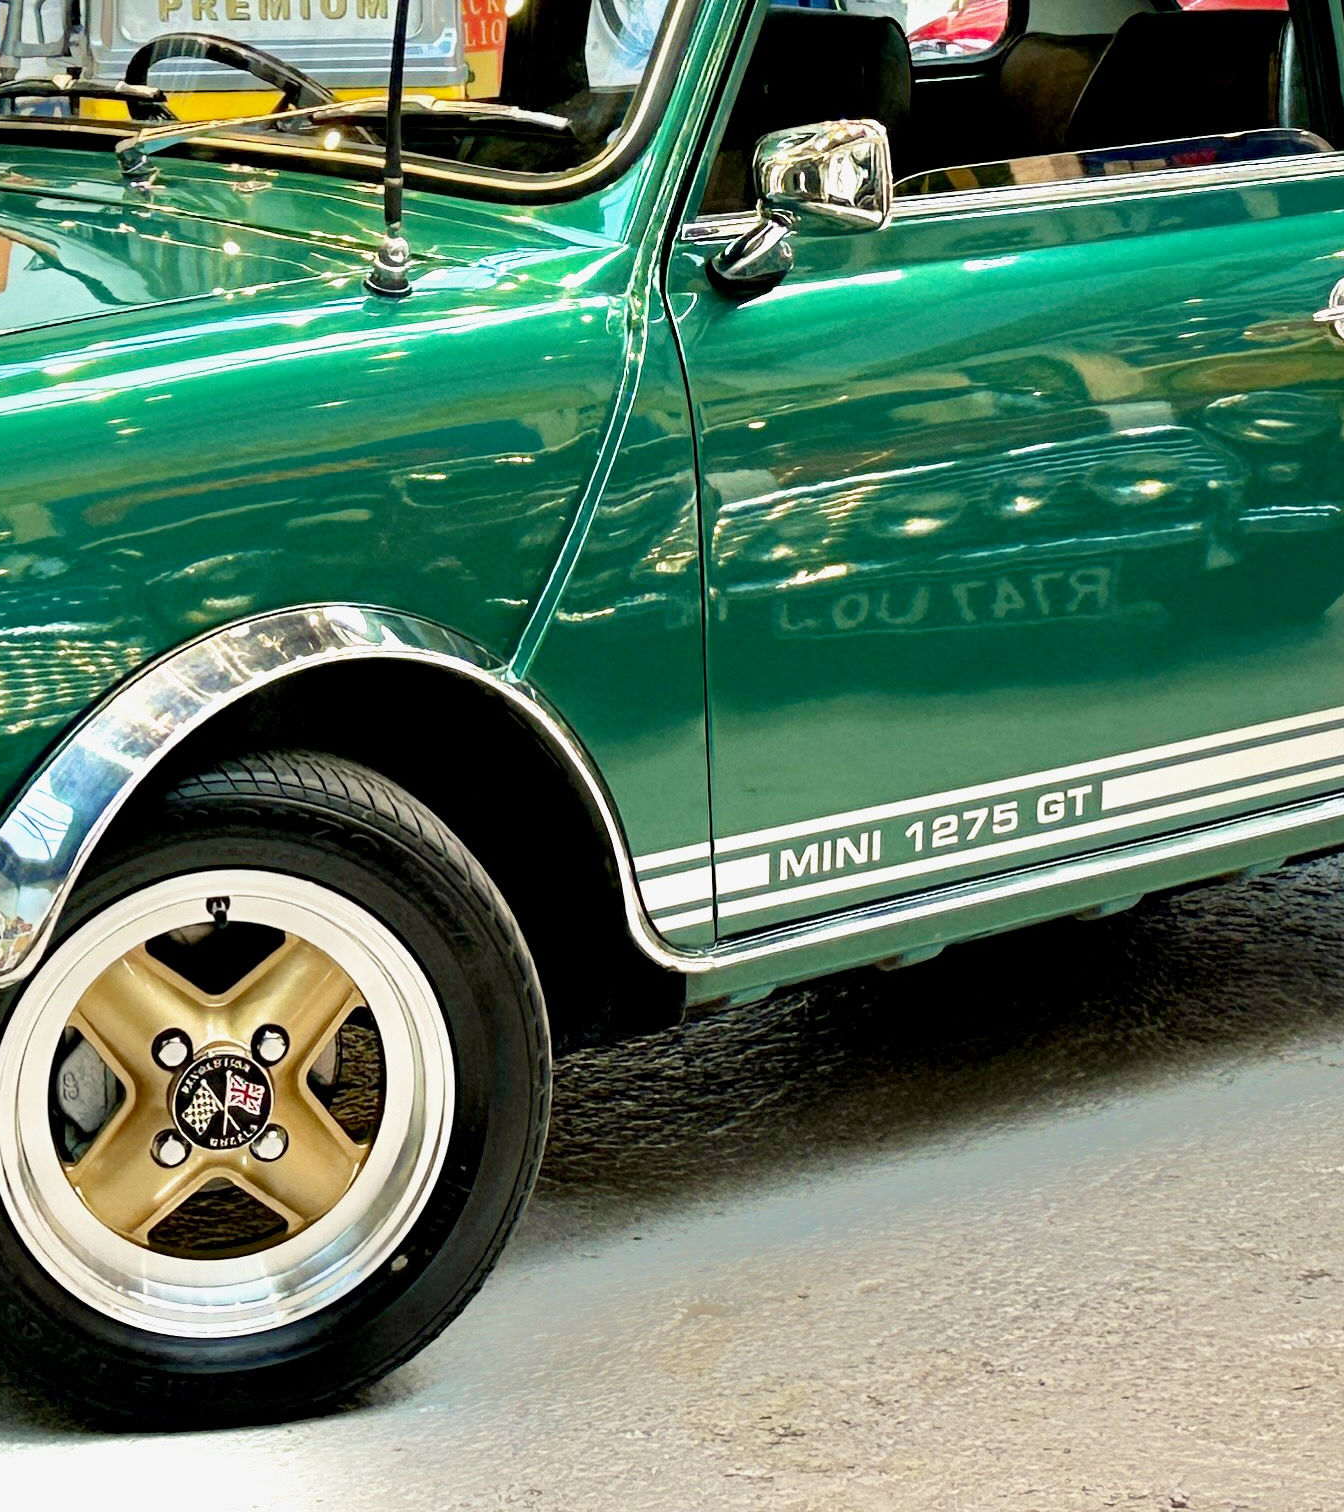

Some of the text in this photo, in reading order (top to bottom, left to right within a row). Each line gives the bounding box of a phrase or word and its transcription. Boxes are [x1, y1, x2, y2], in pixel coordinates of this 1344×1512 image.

[779, 785, 1093, 881] MINI 1275 GT
